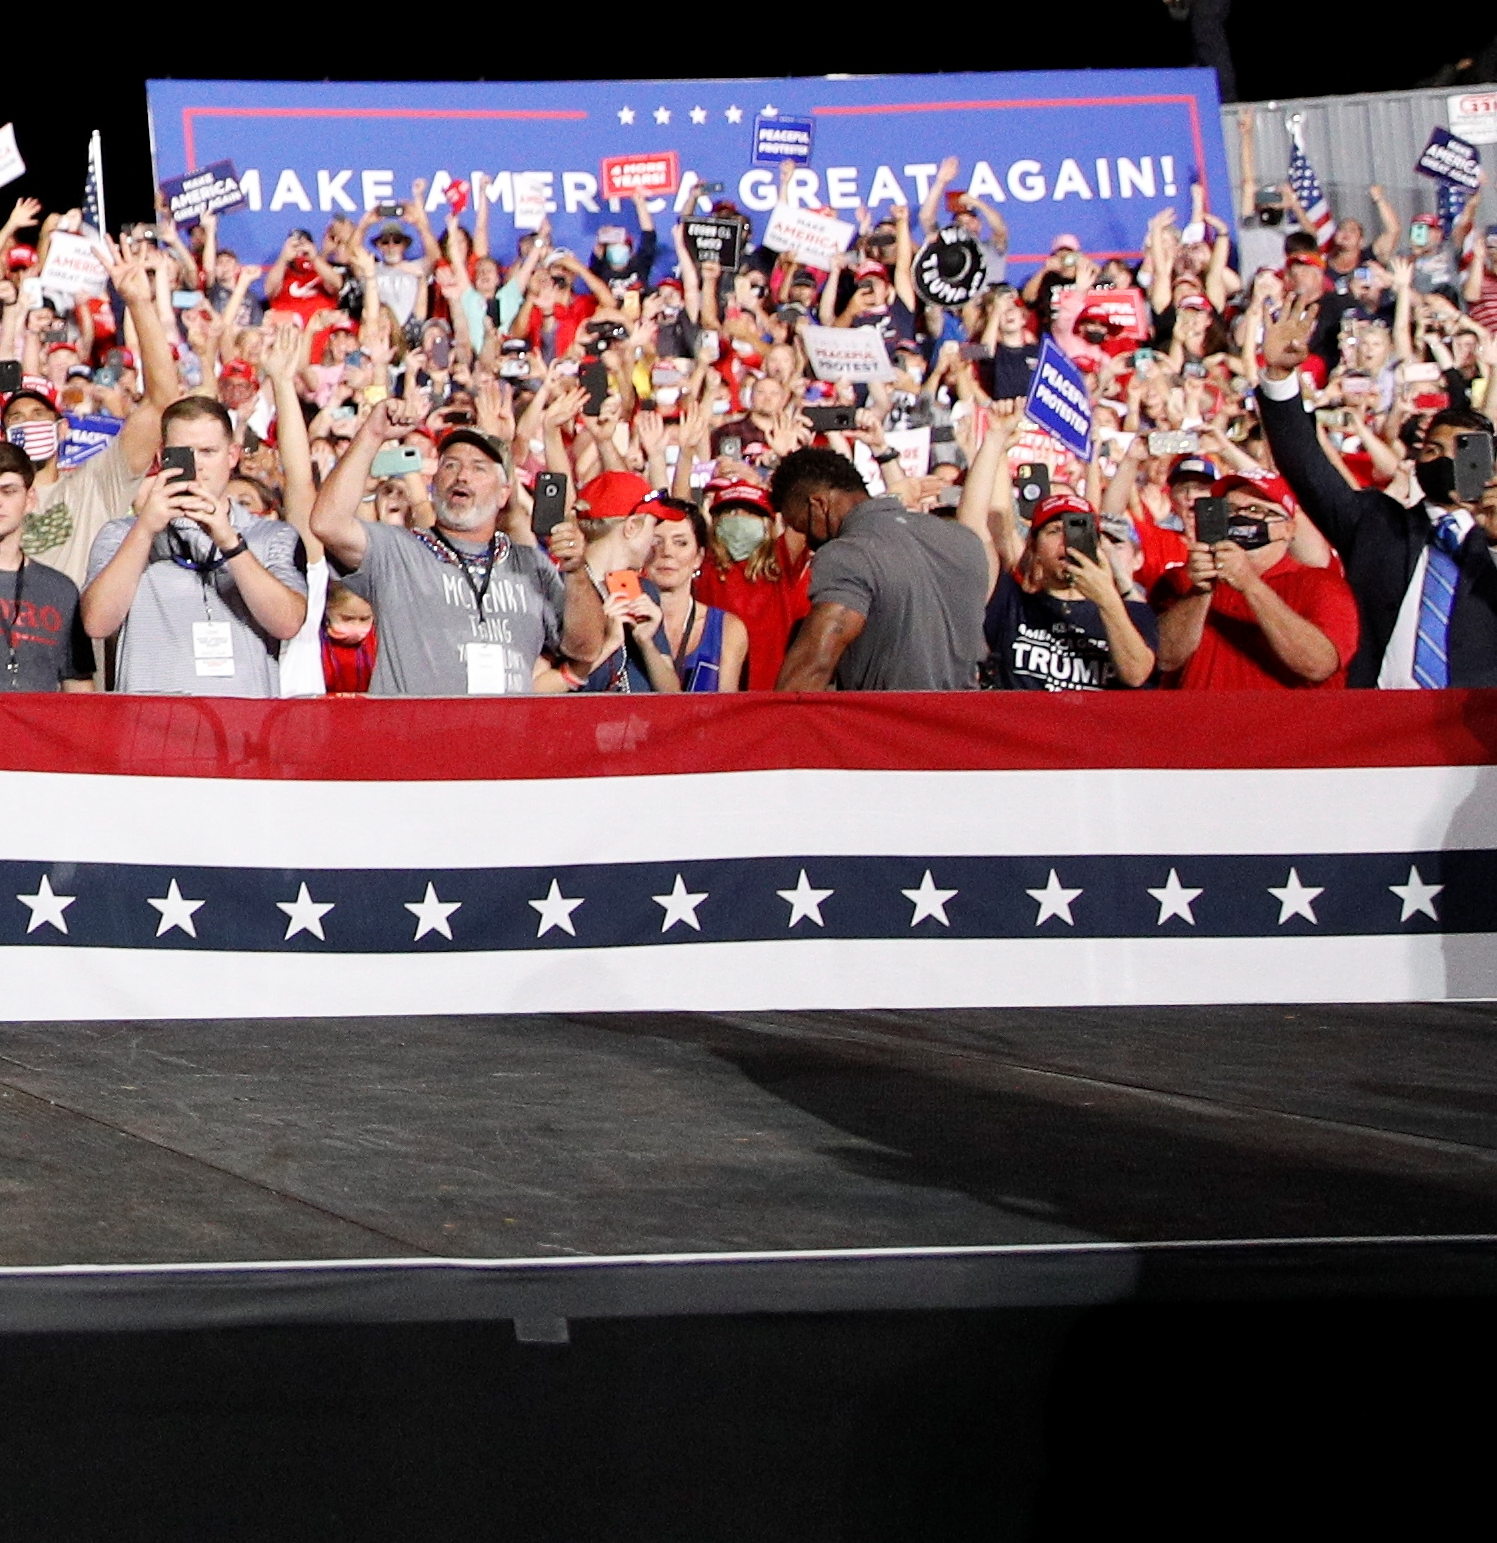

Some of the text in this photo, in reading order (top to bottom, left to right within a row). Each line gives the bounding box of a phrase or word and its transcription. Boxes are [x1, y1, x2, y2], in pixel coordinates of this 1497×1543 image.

[610, 161, 666, 176] 4 MORE
[612, 173, 666, 188] YEARS!
[171, 178, 238, 211] AMERICA
[182, 172, 215, 192] MAKE
[238, 169, 395, 213] MAKE
[738, 163, 937, 211] GREAT
[967, 155, 1177, 204] AGAIN!
[207, 189, 242, 210] AGAIN
[774, 222, 839, 248] AMERICA
[819, 360, 878, 372] PROTEST
[1041, 362, 1090, 415] PEACEFUL
[1036, 384, 1089, 436] PROTESTER
[1011, 642, 1116, 686] TRUMP
